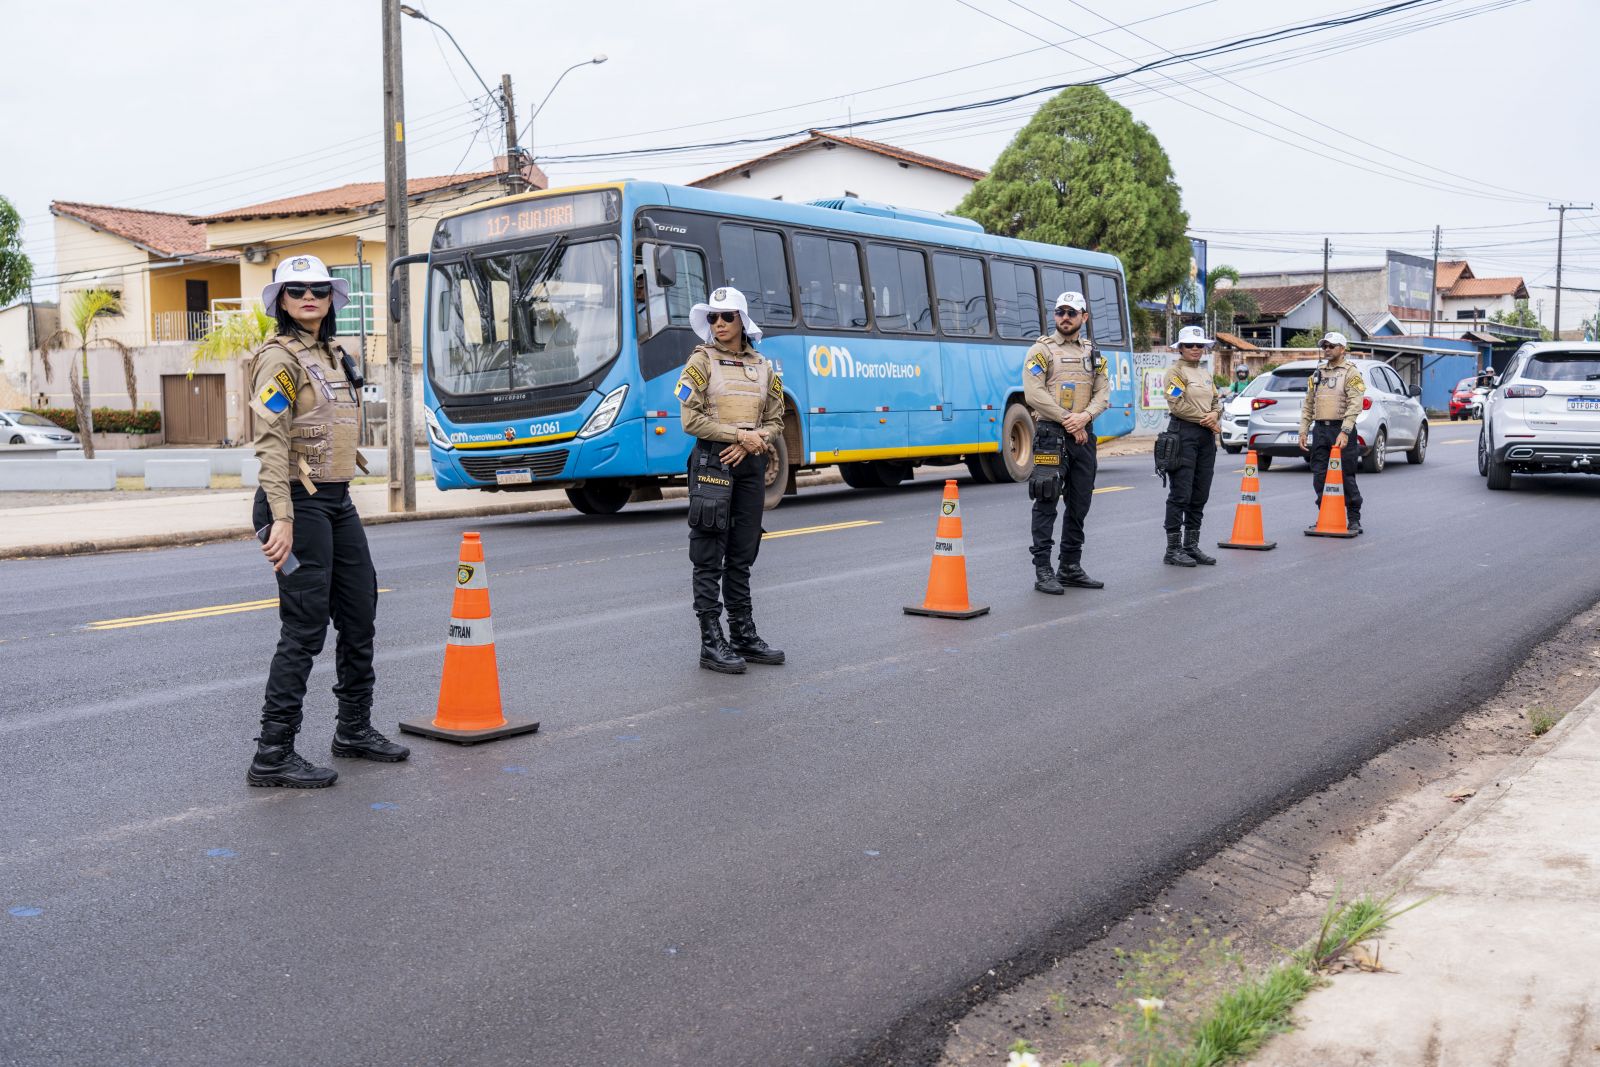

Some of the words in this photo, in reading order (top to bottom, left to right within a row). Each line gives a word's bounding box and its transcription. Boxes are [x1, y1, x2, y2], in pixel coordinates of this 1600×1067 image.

[277, 371, 297, 402] SEMTRAN
[530, 421, 560, 436] 02061
[697, 475, 730, 486] TRÂNSITO
[449, 624, 471, 639] EMTRAN
